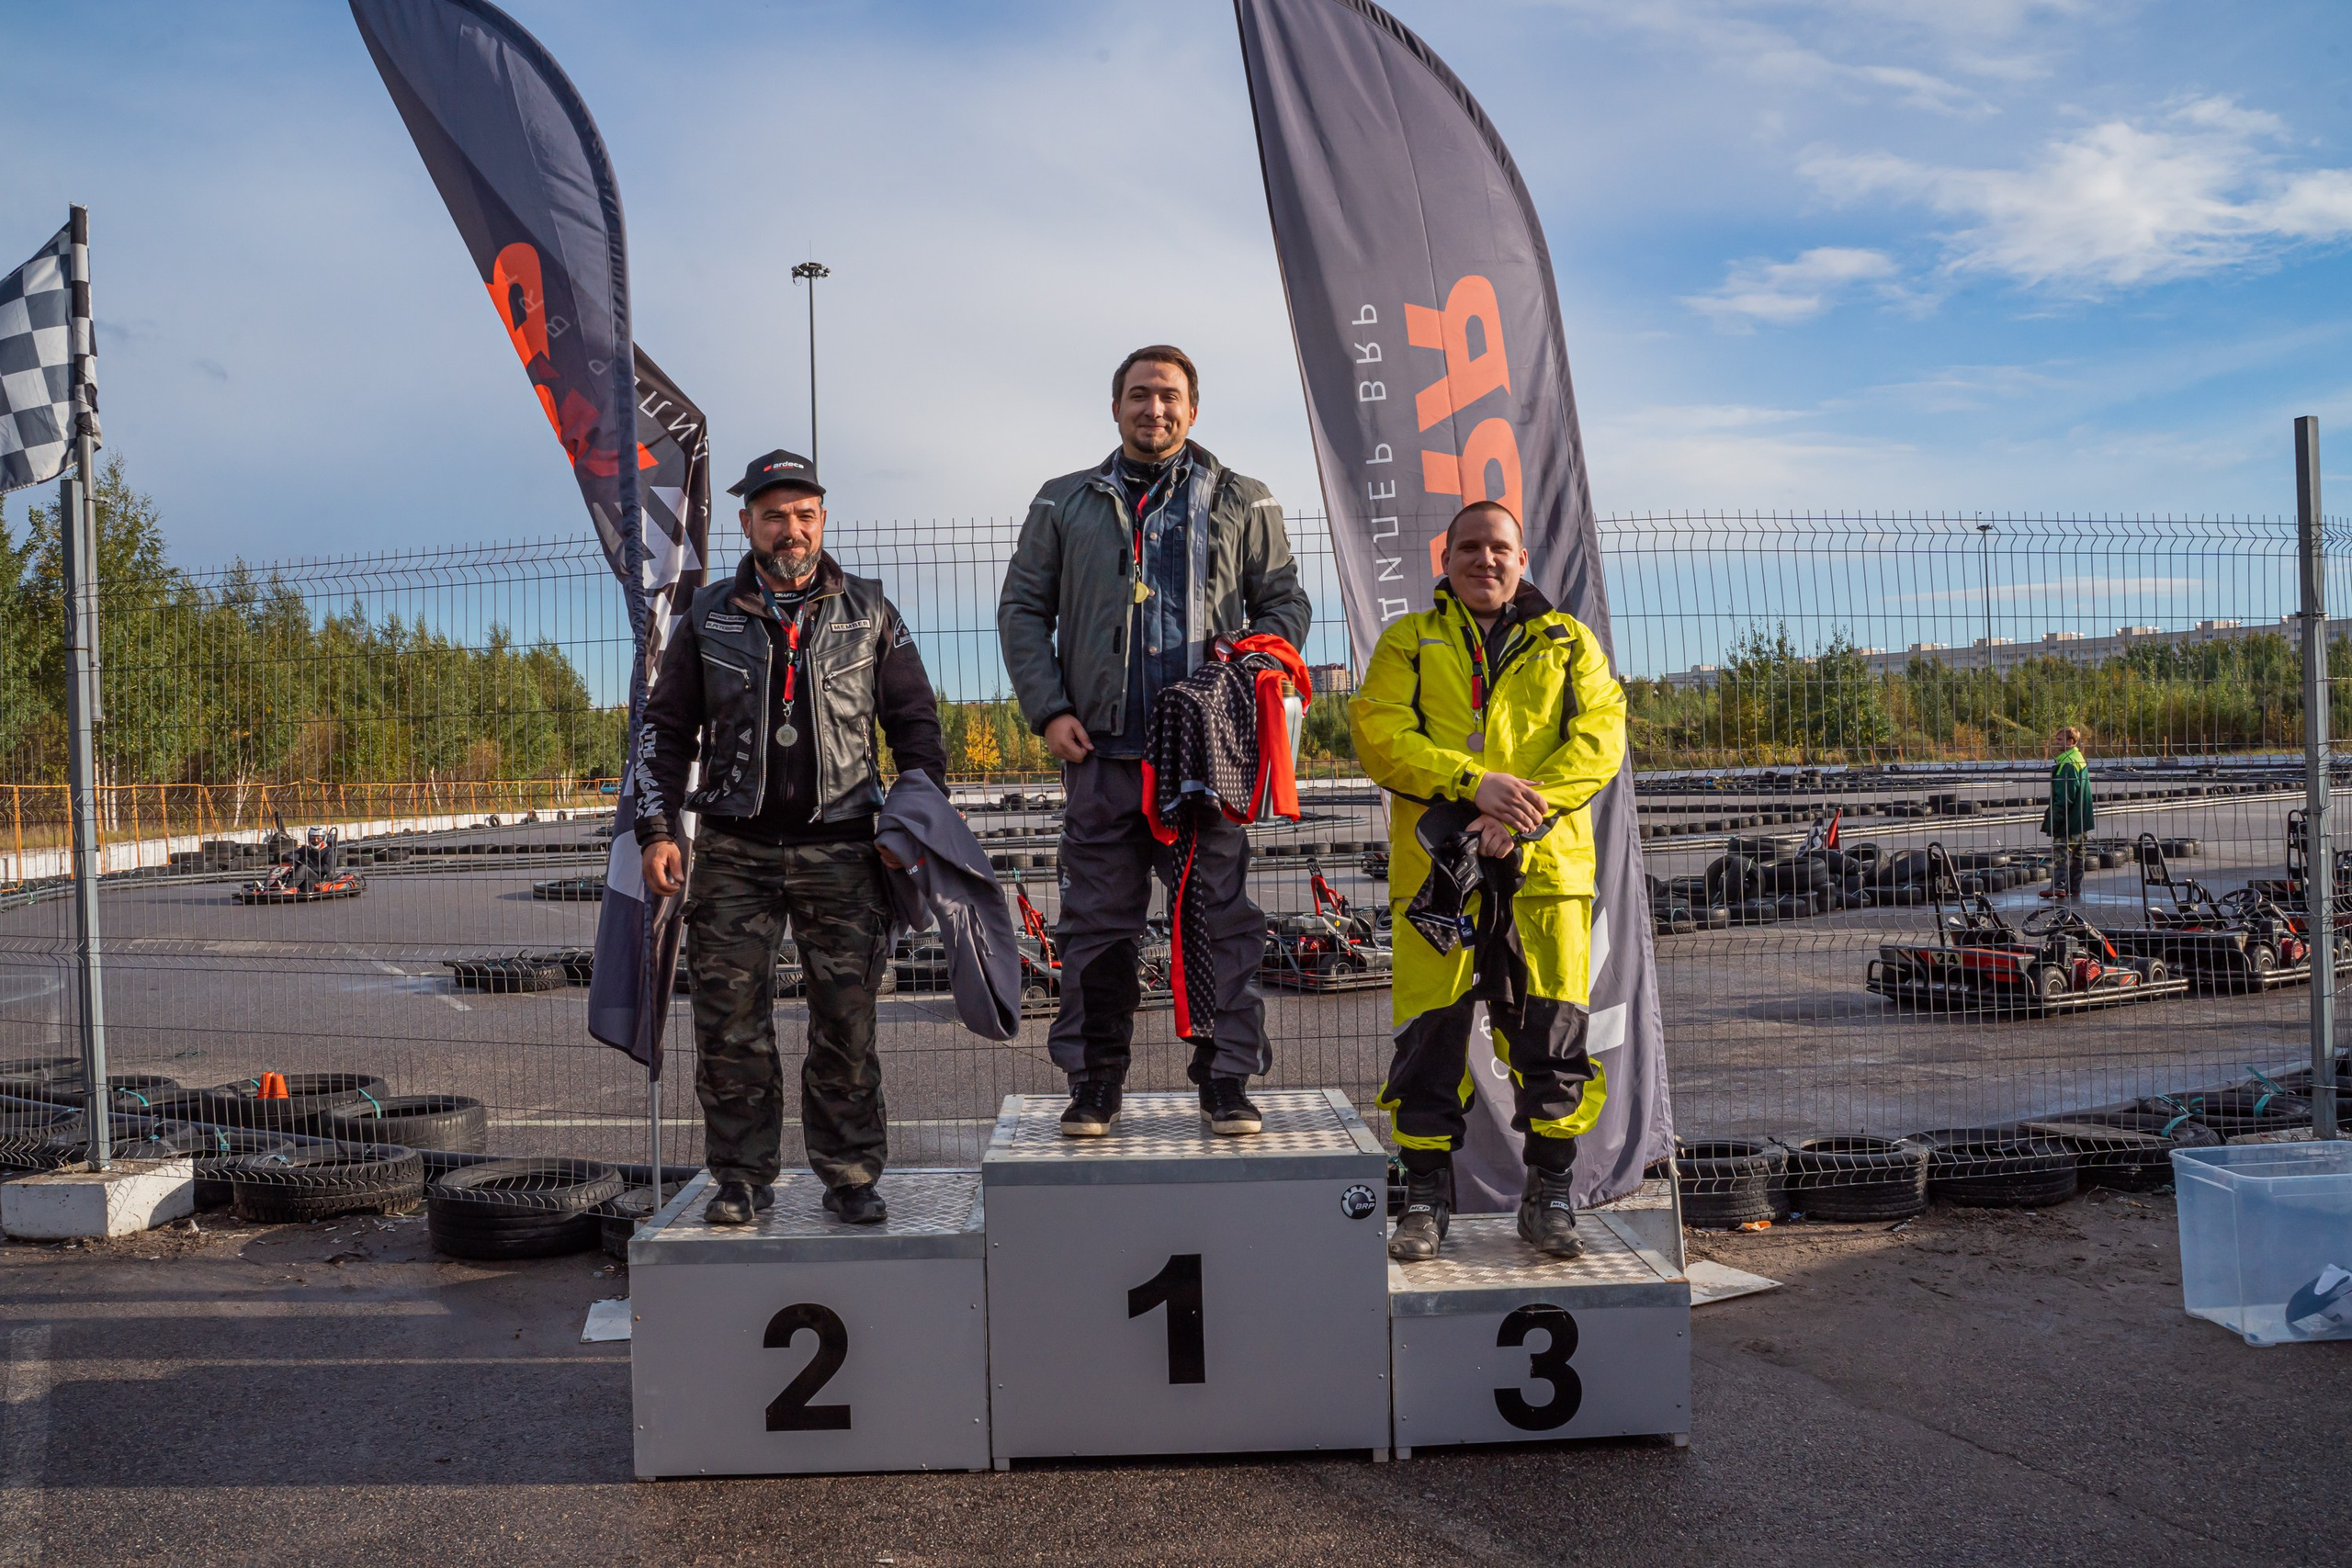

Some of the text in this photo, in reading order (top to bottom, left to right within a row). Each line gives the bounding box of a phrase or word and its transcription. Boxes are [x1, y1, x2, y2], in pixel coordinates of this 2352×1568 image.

[833, 620, 868, 630] MEMBER
[1937, 952, 1958, 964] 24
[763, 1303, 853, 1431] 2
[1128, 1255, 1205, 1384] 1
[1494, 1303, 1582, 1431] 3
